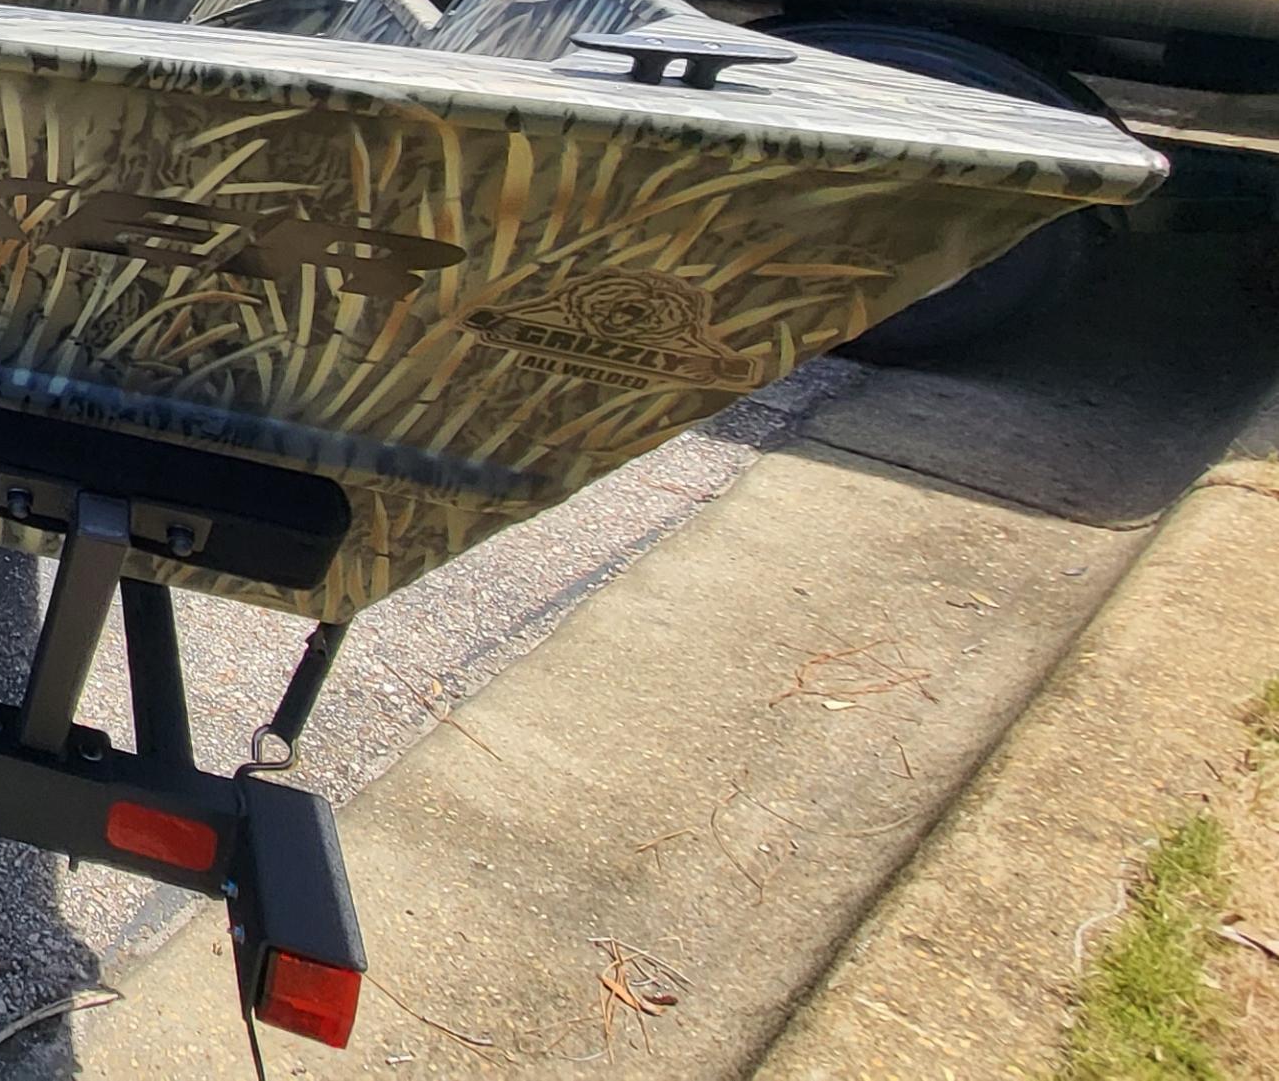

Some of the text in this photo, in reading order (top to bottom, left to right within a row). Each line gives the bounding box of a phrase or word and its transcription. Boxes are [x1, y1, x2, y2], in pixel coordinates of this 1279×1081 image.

[516, 324, 685, 371] GRIZZLY
[522, 355, 650, 390] ALL WELDED
